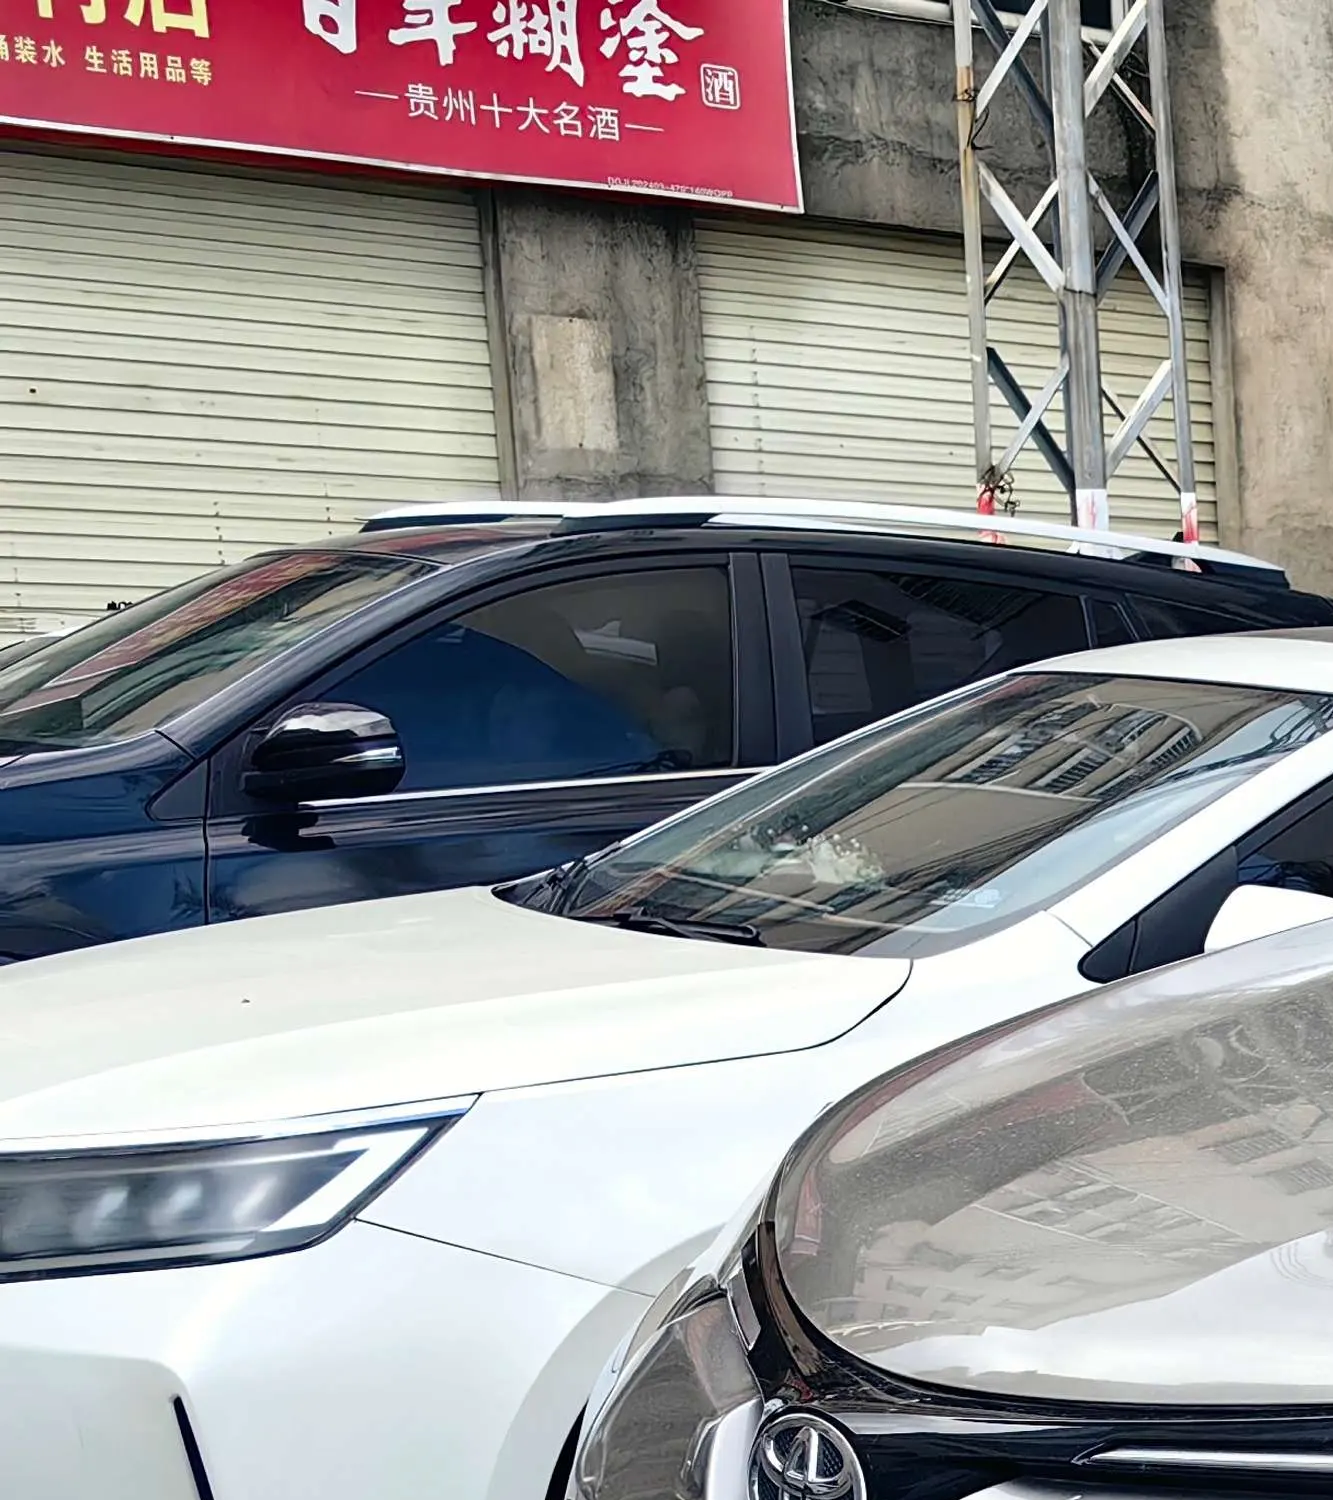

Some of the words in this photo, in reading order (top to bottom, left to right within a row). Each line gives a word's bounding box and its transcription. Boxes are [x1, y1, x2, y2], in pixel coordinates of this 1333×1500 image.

[84, 46, 213, 86] 生活用品等
[703, 67, 736, 106] 酒
[404, 82, 620, 142] 贵州十大名酒
